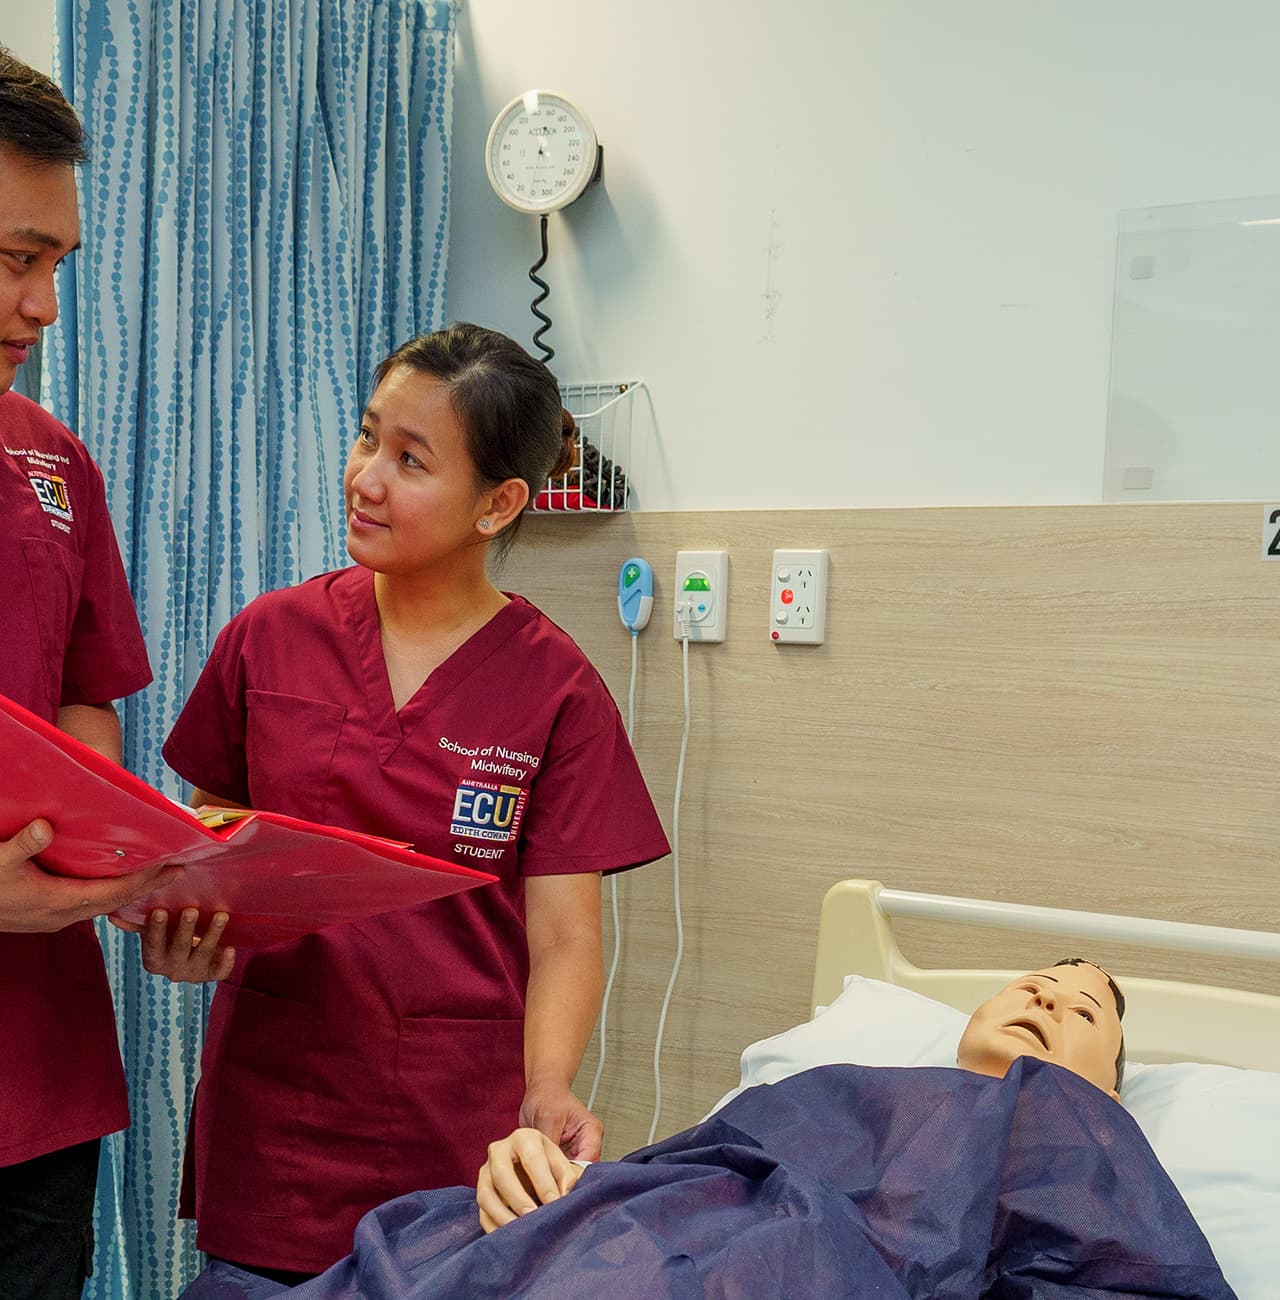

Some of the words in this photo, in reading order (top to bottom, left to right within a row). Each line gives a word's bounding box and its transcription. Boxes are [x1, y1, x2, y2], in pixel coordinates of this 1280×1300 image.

[29, 478, 67, 510] ECU
[438, 737, 479, 757] School
[480, 746, 494, 757] of
[496, 746, 540, 768] Nursing
[470, 759, 527, 781] Midwifery
[461, 779, 499, 791] AUSTRALIA
[452, 788, 516, 828] ECU
[509, 790, 528, 841] UNIVERSITY
[452, 825, 480, 837] EDITH
[481, 830, 509, 840] COWAN
[454, 843, 505, 860] STUDENT
